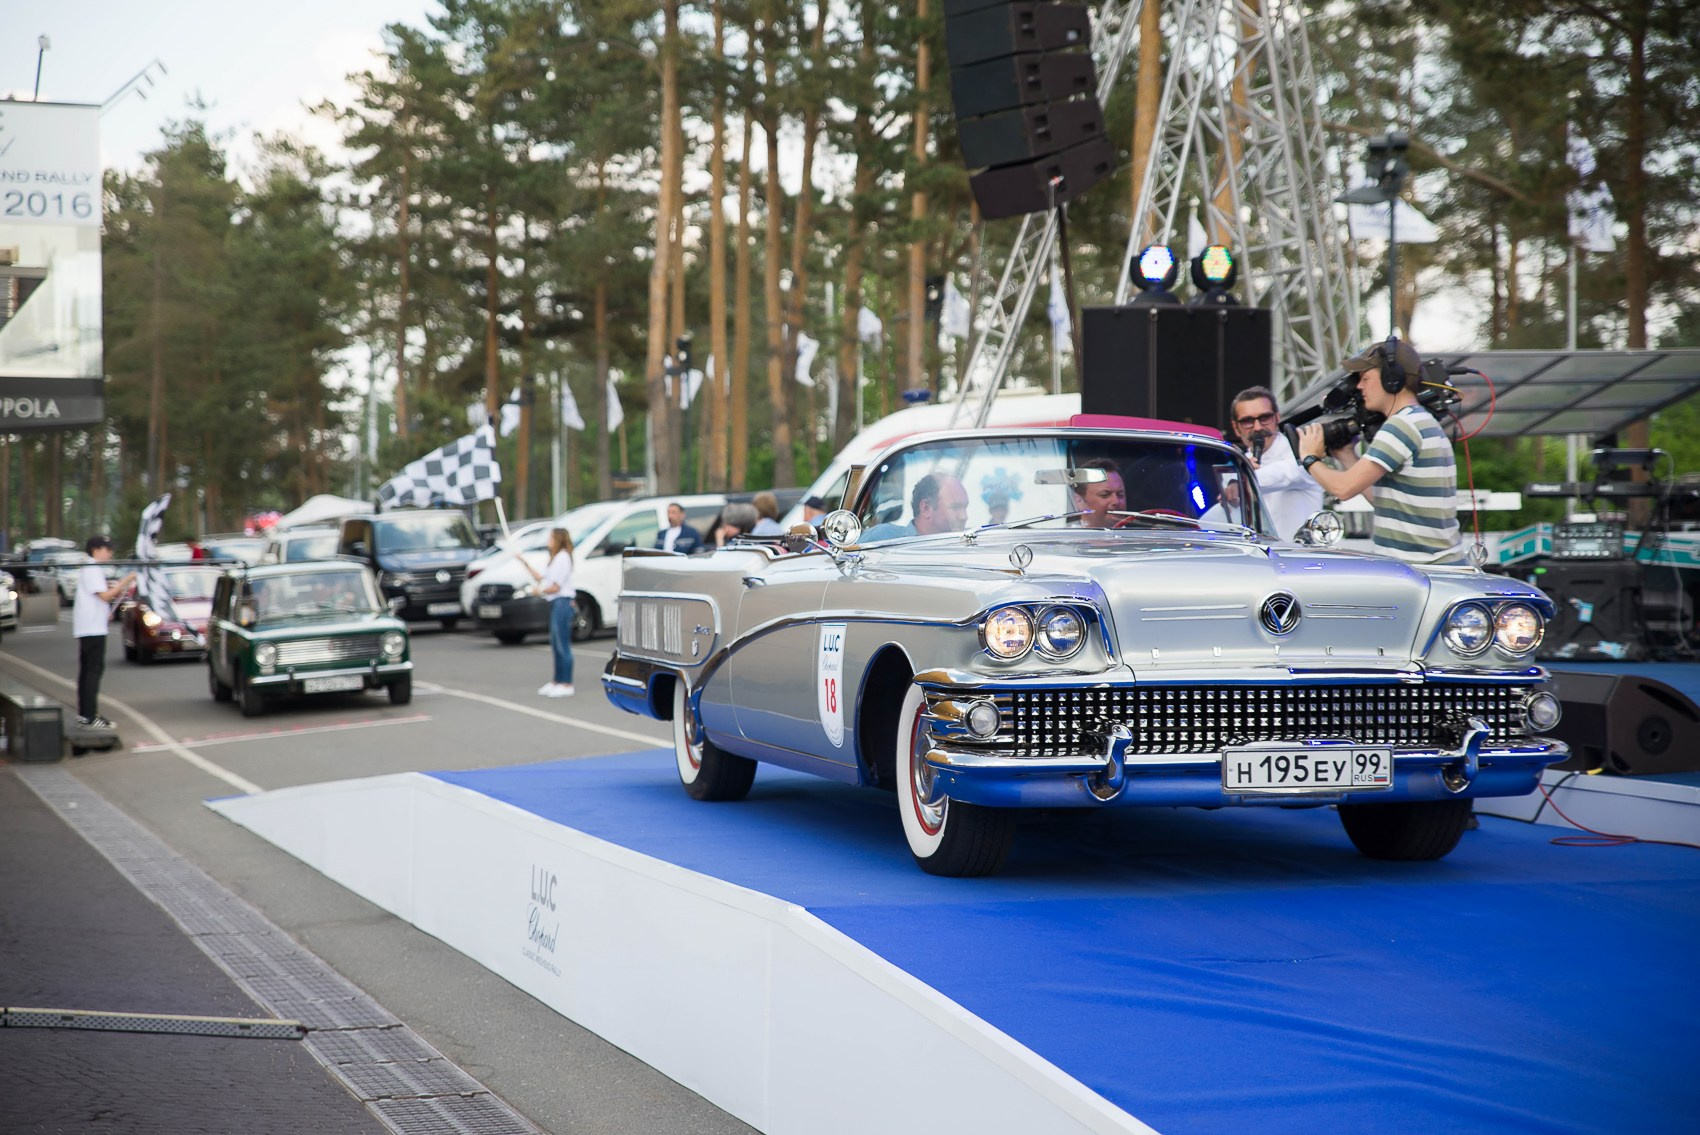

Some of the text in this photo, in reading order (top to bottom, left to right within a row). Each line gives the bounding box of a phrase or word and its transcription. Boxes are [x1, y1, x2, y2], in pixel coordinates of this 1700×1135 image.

[35, 170, 92, 185] RALLY
[4, 188, 93, 218] 2016
[0, 397, 61, 418] POLA
[825, 678, 836, 714] 18
[1355, 753, 1381, 775] 99
[1354, 774, 1373, 782] RUS
[531, 863, 558, 912] L.U.C
